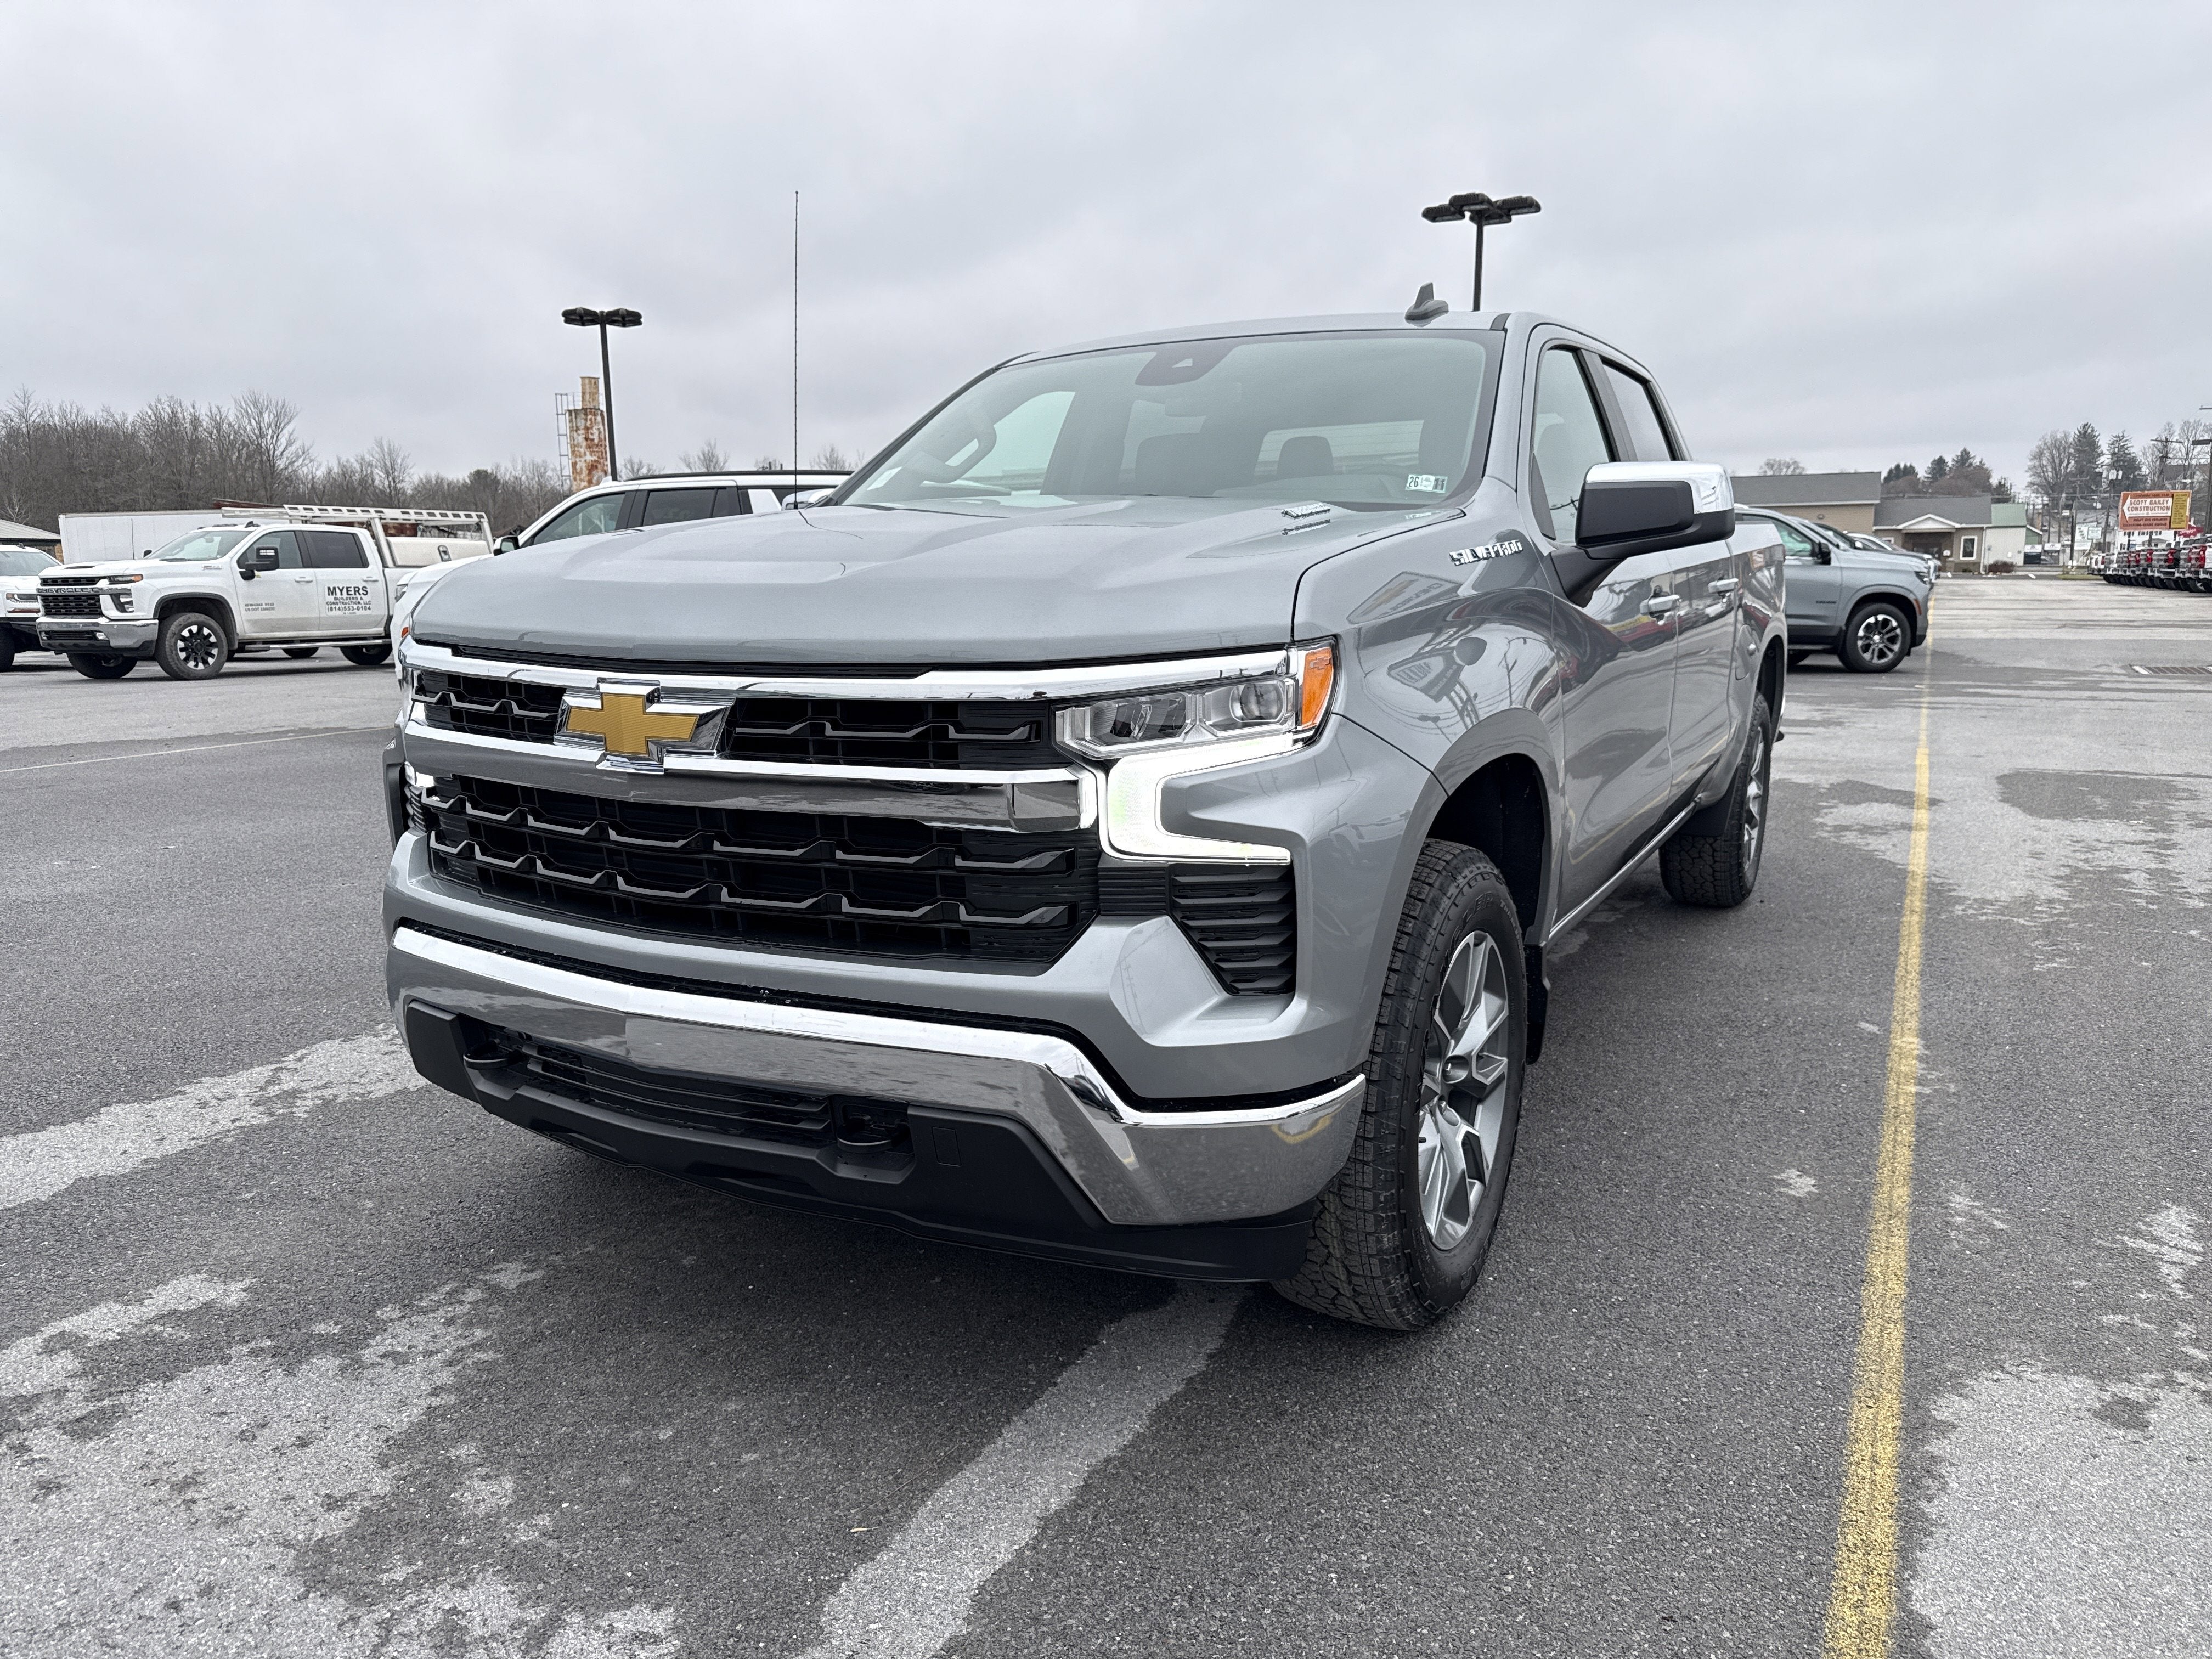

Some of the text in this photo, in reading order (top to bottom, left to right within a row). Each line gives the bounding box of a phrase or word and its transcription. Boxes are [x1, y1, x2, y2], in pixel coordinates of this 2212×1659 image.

[1408, 476, 1419, 488] 26
[1449, 539, 1523, 567] SILVERADO
[326, 585, 369, 596] MYERS
